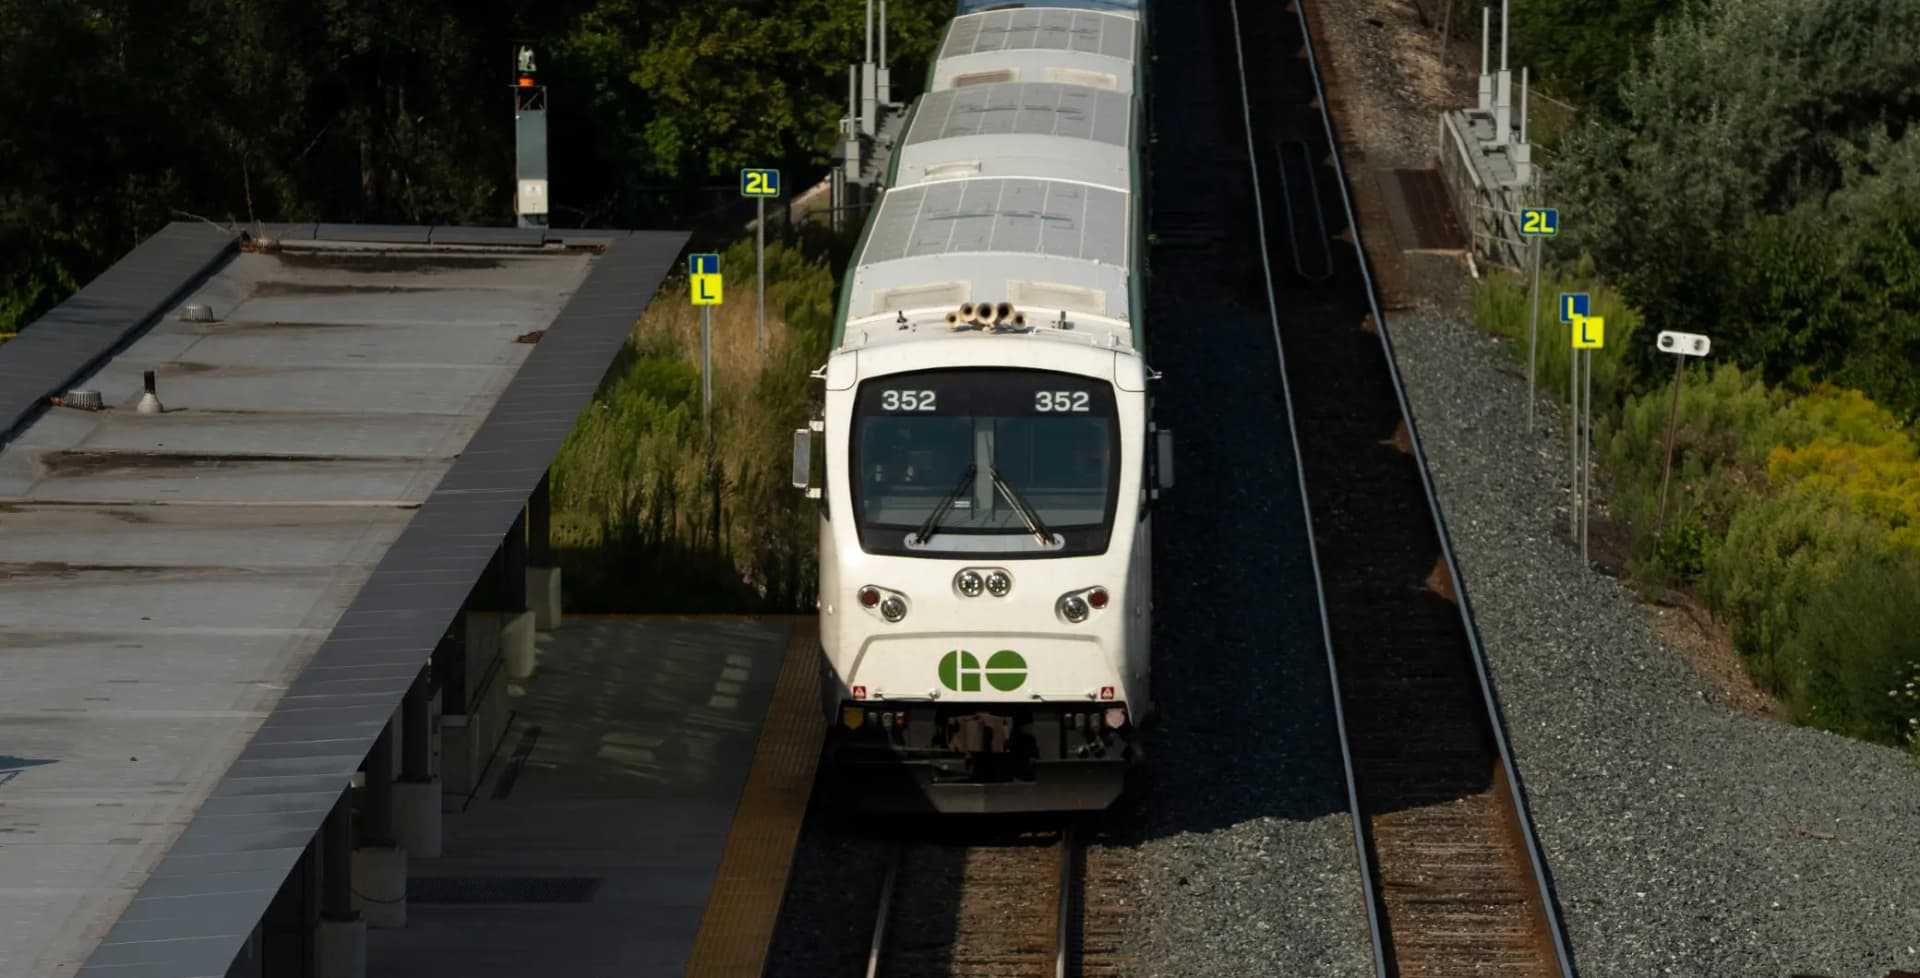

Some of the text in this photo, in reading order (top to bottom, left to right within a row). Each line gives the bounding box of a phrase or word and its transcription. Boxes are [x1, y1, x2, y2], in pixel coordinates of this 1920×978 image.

[745, 171, 776, 193] 2L
[1523, 211, 1554, 233] 2L
[700, 278, 715, 299] L
[1582, 321, 1596, 343] L
[881, 390, 936, 411] 352
[1035, 391, 1090, 412] 352
[938, 650, 1028, 692] GO
